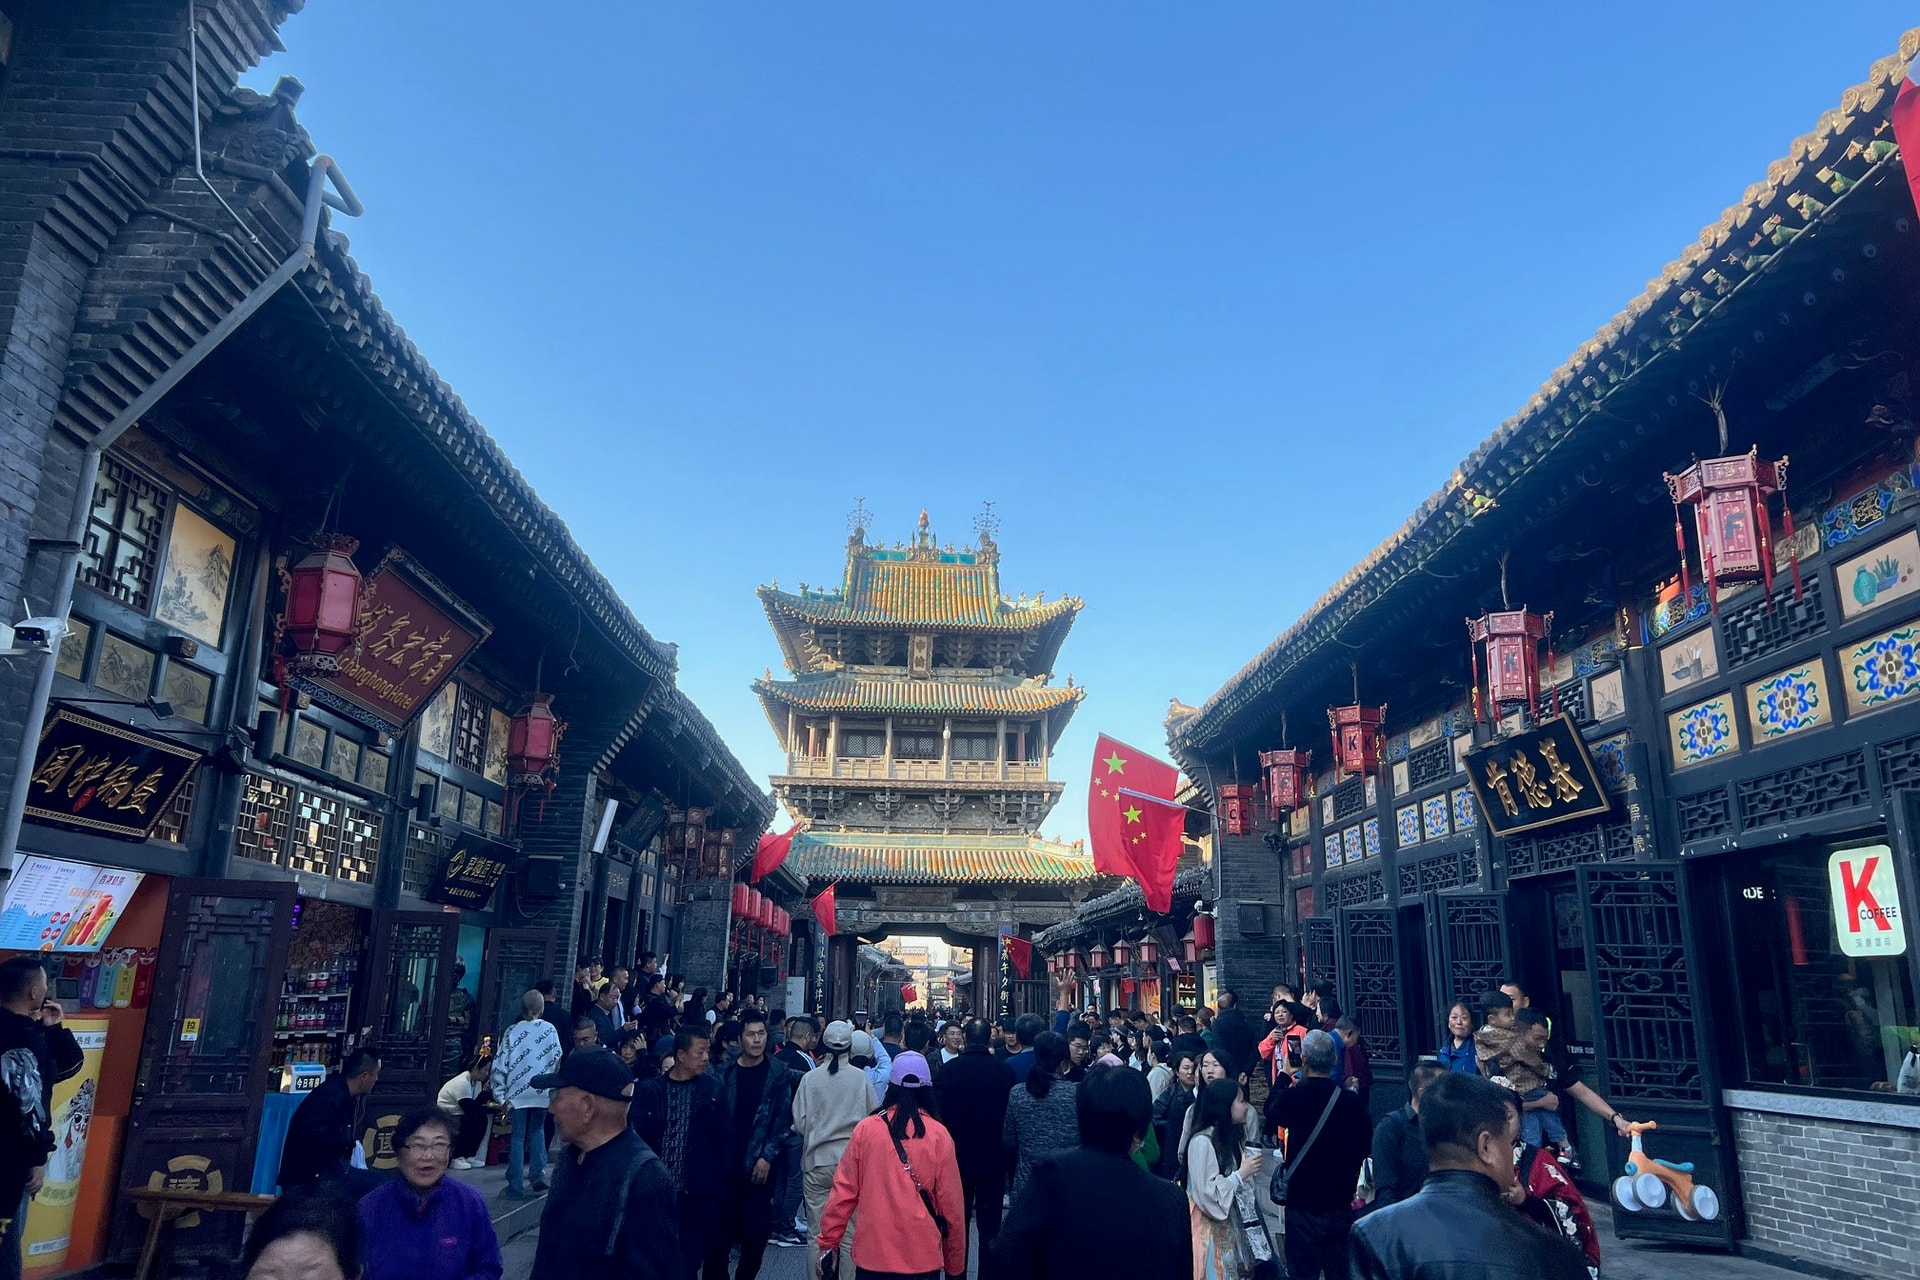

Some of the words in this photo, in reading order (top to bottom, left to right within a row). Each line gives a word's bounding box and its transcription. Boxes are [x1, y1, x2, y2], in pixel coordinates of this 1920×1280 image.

[1348, 736, 1358, 750] K
[1364, 735, 1373, 750] K
[1485, 737, 1584, 816] 肯德基
[1229, 808, 1237, 820] C
[1240, 809, 1248, 821] C
[1839, 857, 1892, 933] K
[1860, 906, 1898, 920] COFFEE
[186, 1020, 196, 1031] 拉
